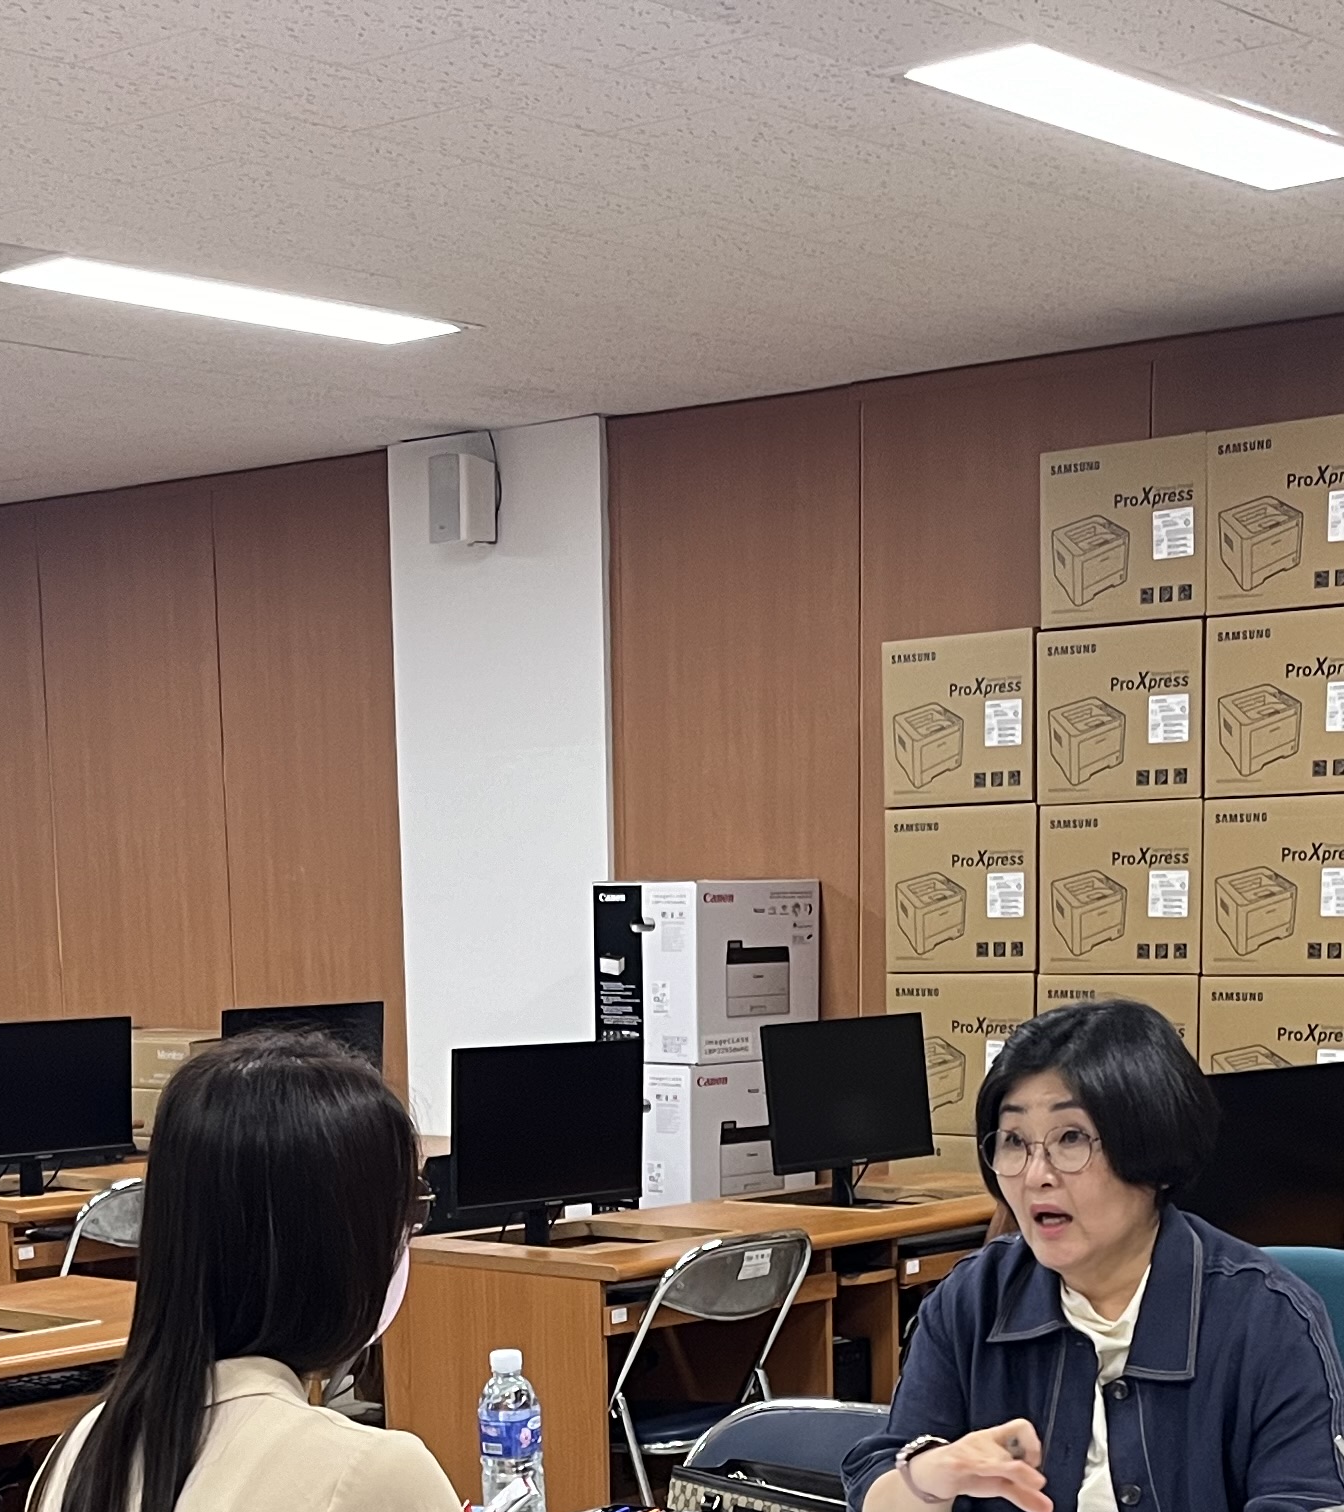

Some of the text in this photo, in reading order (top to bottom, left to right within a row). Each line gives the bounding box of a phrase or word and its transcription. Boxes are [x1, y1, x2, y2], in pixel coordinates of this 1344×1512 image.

[1218, 439, 1271, 455] SAMSUNG
[1051, 461, 1099, 475] SAMSUNG
[1115, 486, 1193, 508] ProXpress
[1218, 628, 1270, 642] SAMSUNG
[1048, 644, 1096, 656] SAMSUNG
[892, 652, 936, 664] SAMSUNG
[950, 677, 1021, 698] ProXpress
[1111, 671, 1188, 692] ProXpress
[1050, 818, 1098, 829] SAMSUNG
[1216, 813, 1267, 823] SAMSUNG
[894, 822, 938, 833] SAMSUNG
[952, 850, 1023, 870] ProXpress
[1112, 847, 1189, 868] ProXpress
[703, 892, 734, 903] Canon
[896, 988, 939, 997] SAMSUNG
[1048, 990, 1095, 999] SAMSUNG
[1212, 992, 1263, 1001] SAMSUNG
[697, 1076, 728, 1087] Canon
